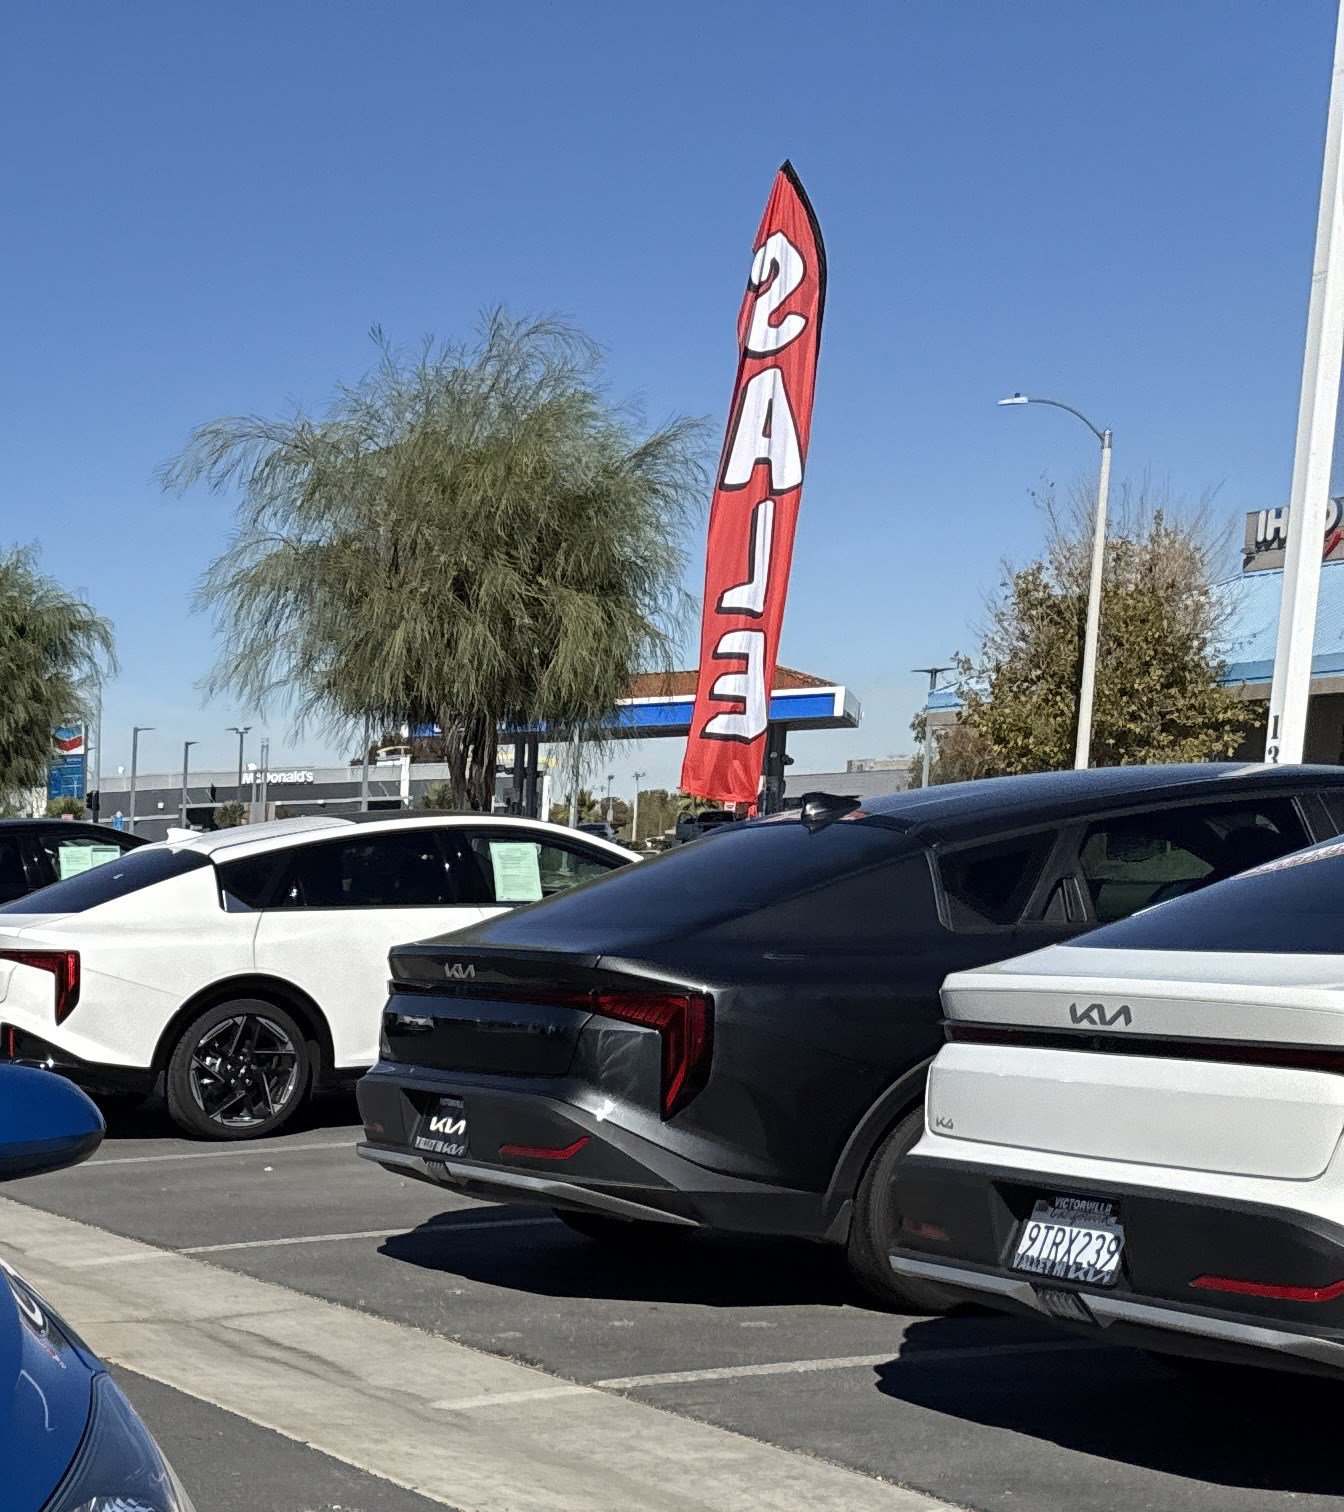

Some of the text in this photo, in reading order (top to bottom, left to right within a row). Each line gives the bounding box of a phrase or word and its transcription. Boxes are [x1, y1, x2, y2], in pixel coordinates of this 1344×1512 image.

[444, 963, 476, 979] KIA
[1069, 1002, 1133, 1027] KIA
[429, 1116, 467, 1136] KIA
[936, 1116, 954, 1130] K4
[1019, 1223, 1122, 1271] 9TRX239
